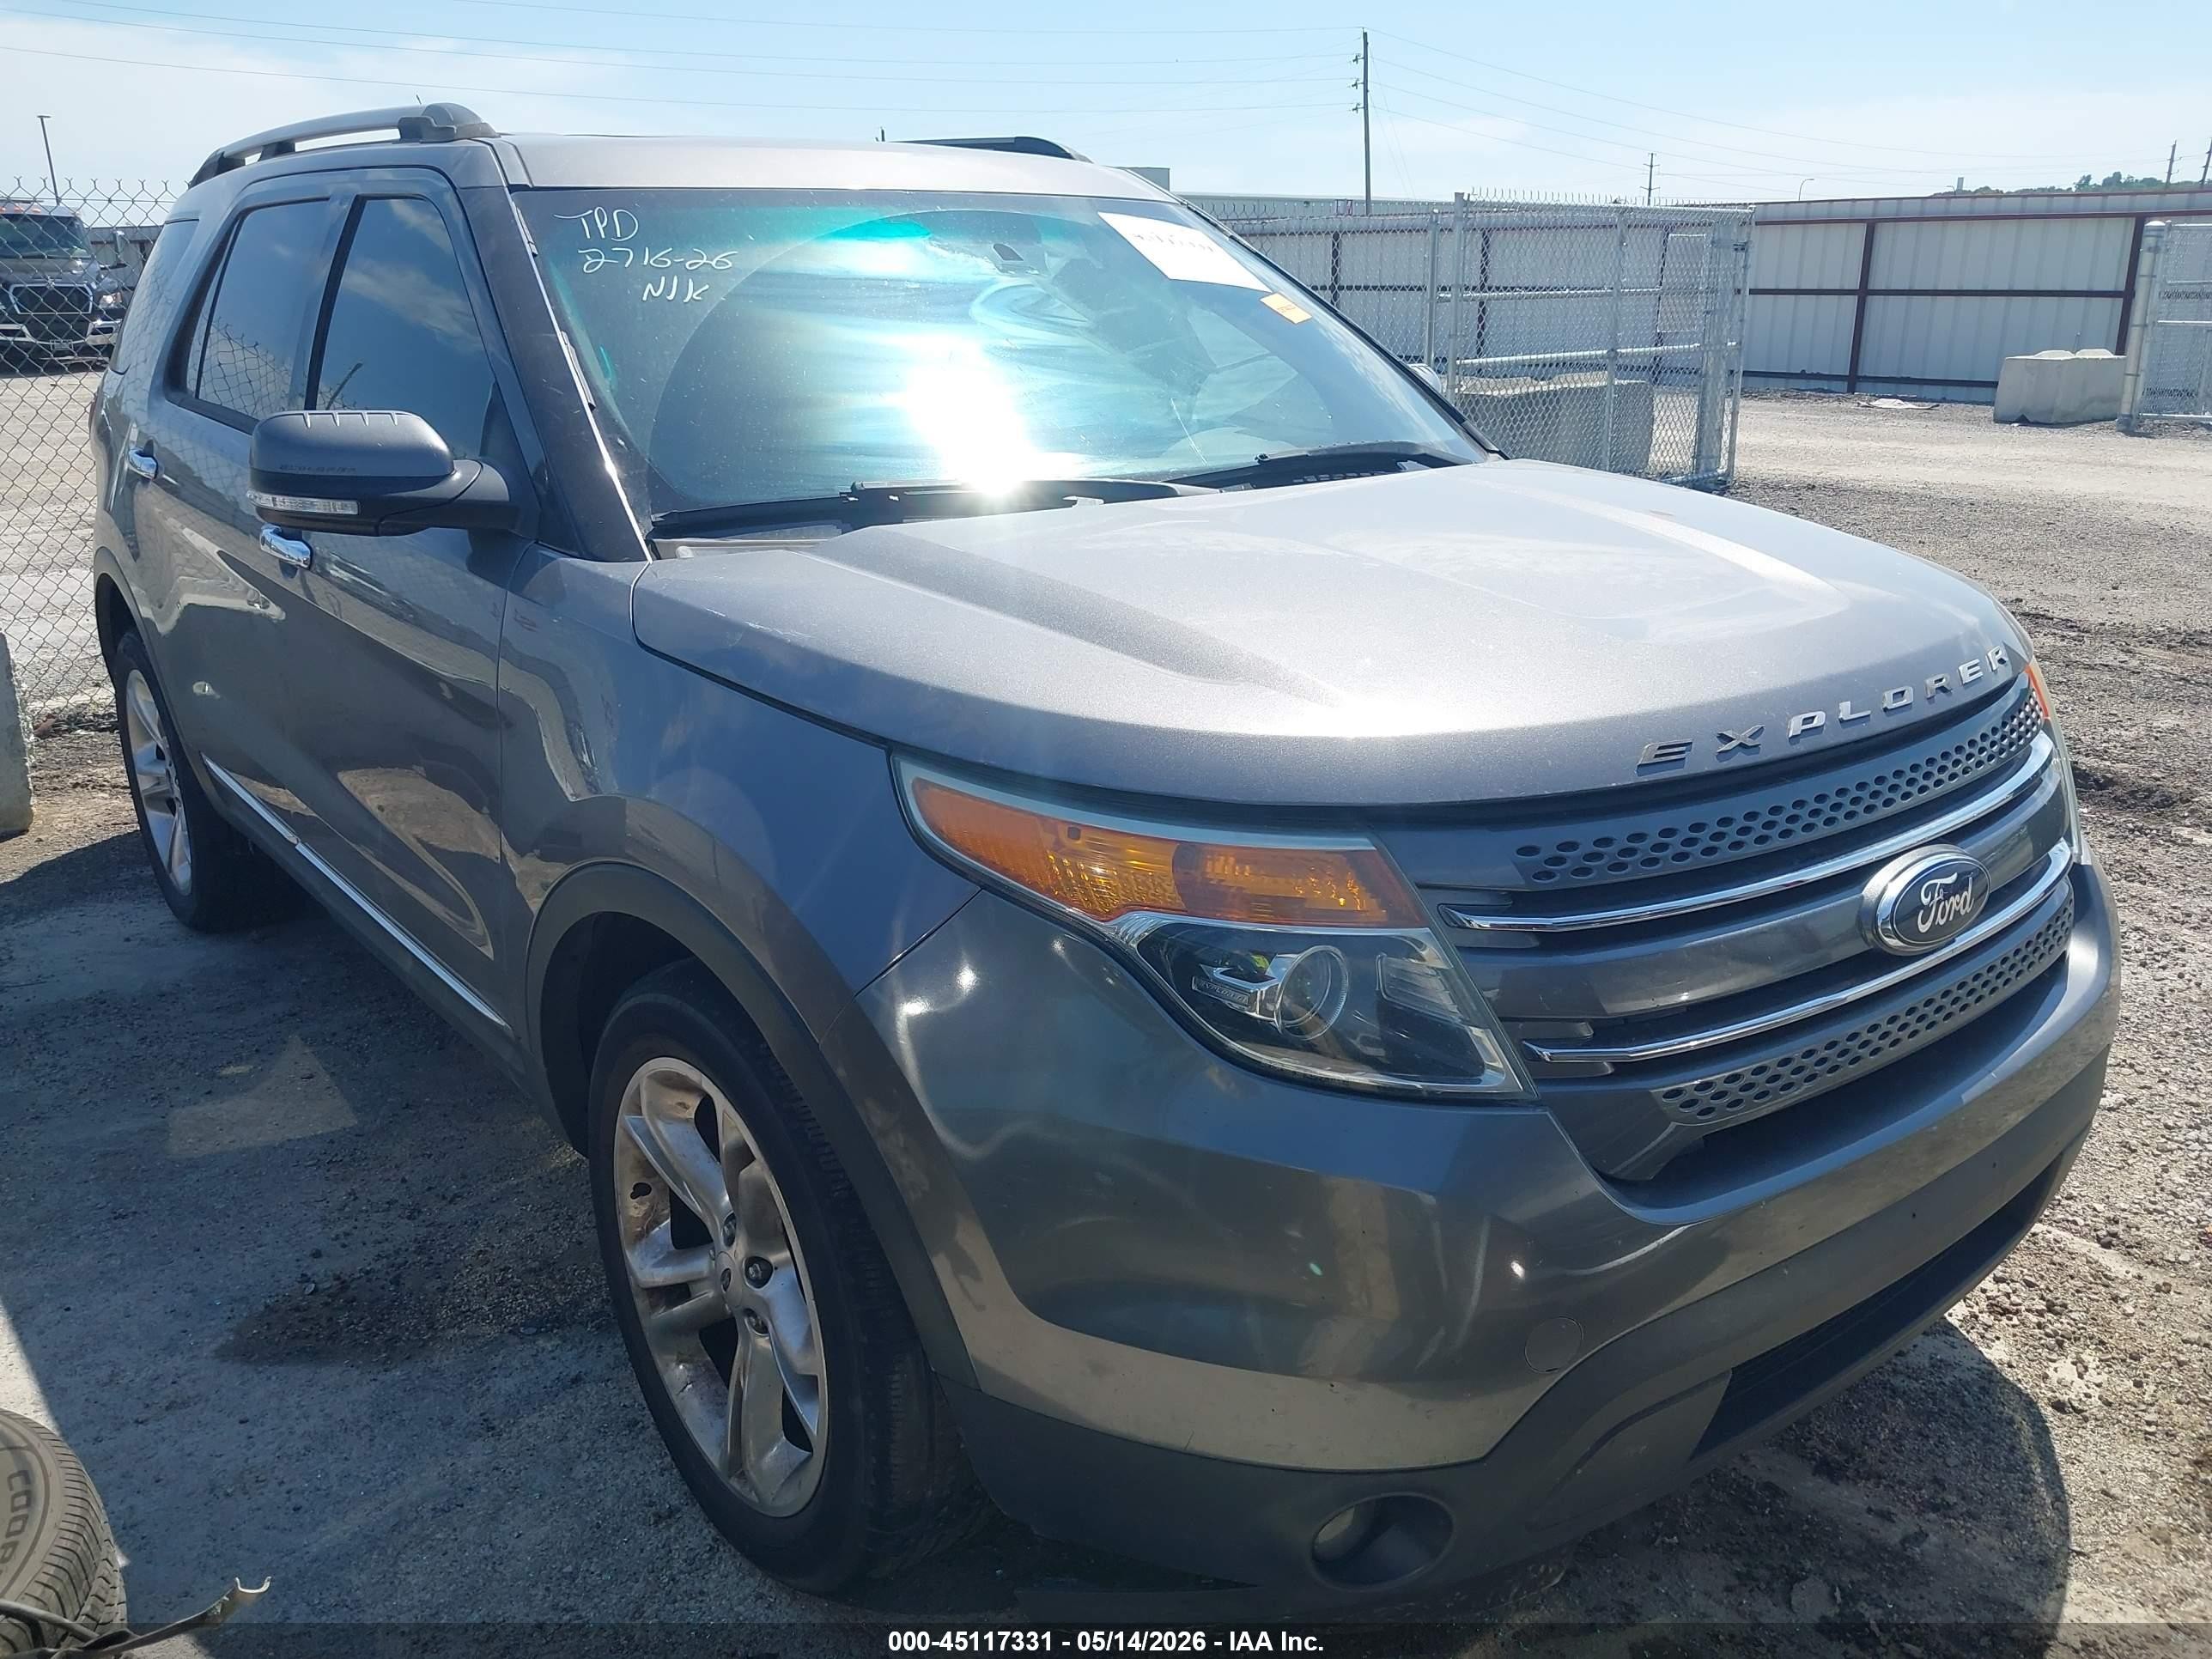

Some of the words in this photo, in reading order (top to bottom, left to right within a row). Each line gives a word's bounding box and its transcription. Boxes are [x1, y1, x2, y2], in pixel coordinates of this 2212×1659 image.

[553, 207, 639, 241] TPD
[1635, 644, 2008, 771] EXPLORER
[1917, 872, 1975, 933] Ford
[0, 1469, 31, 1576] COOP
